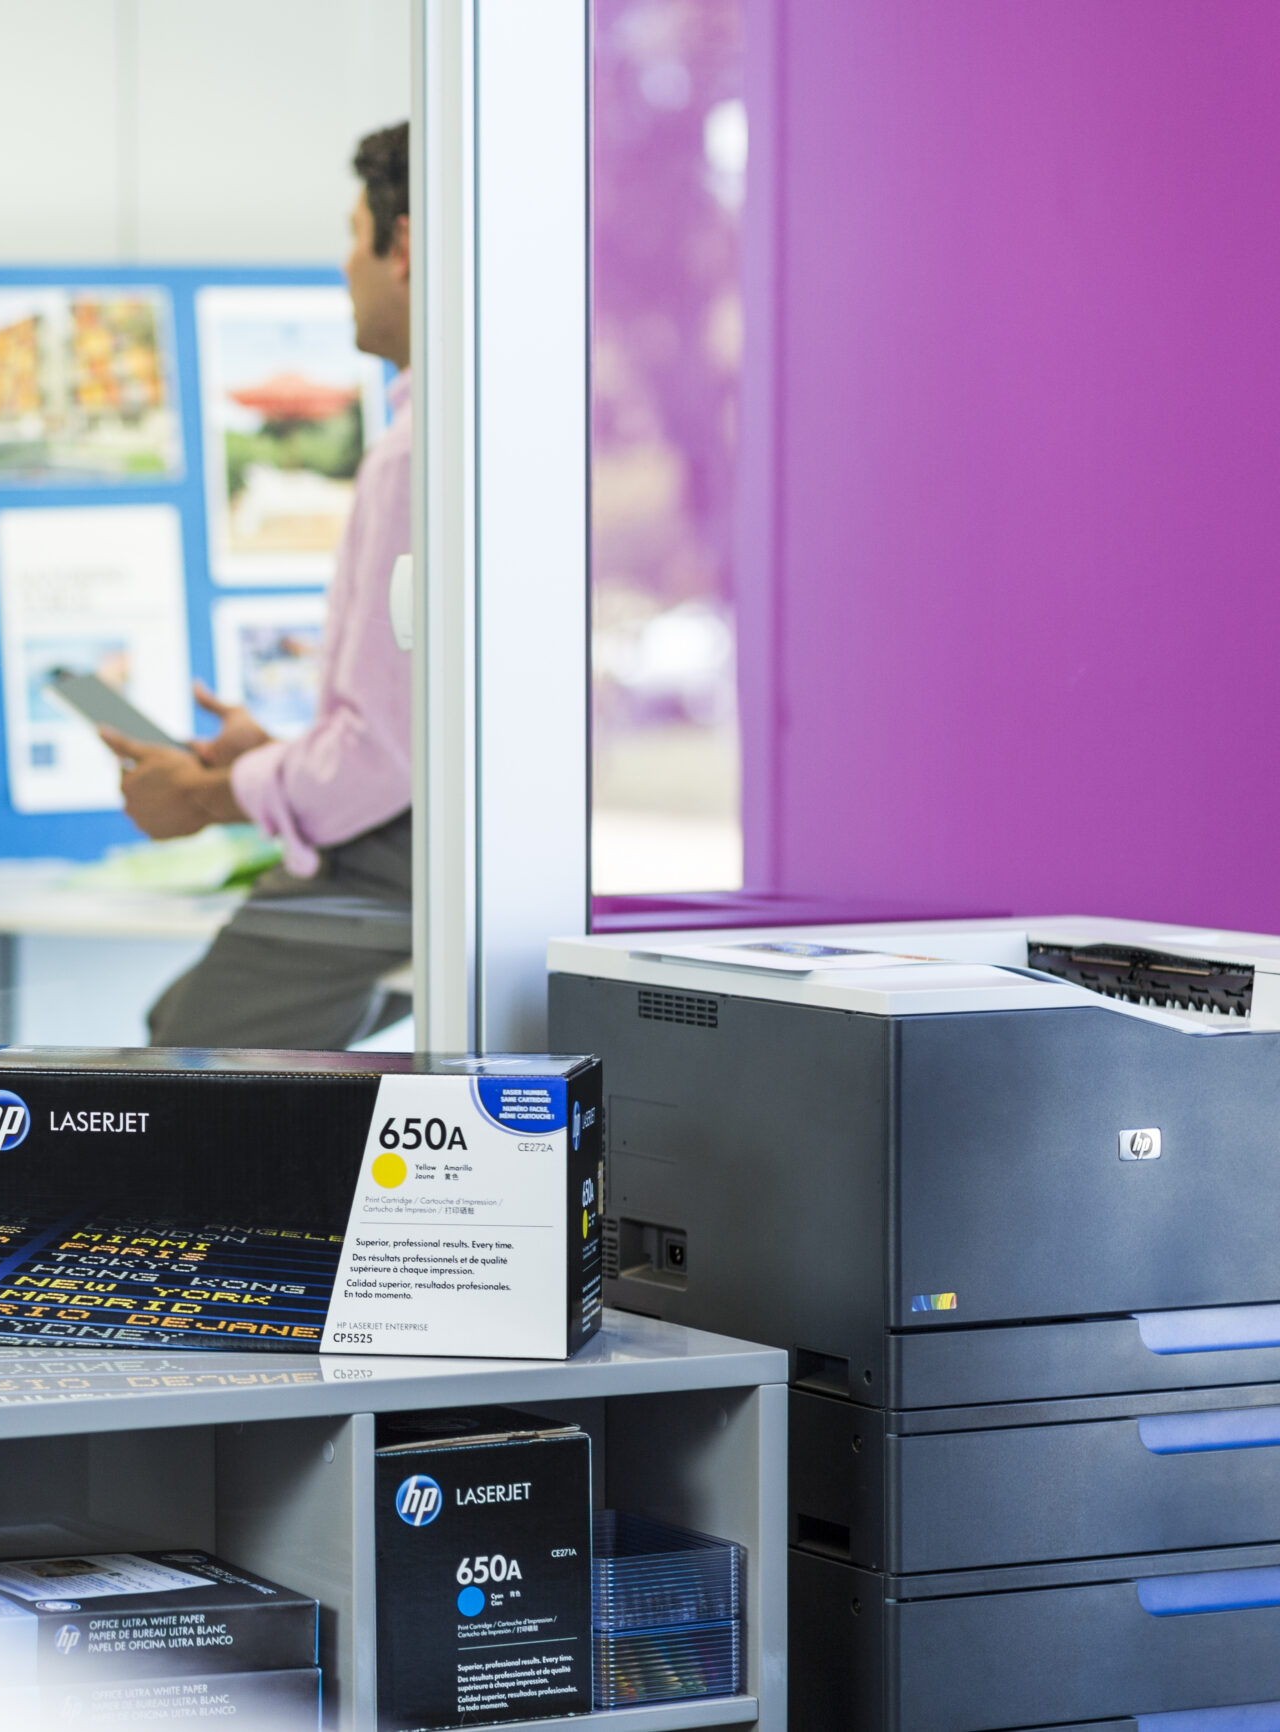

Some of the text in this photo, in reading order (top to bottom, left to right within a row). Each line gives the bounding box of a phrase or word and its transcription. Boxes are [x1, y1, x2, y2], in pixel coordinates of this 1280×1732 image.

[50, 1111, 150, 1132] LASERJET
[379, 1117, 468, 1150] 650A
[518, 1142, 554, 1152] CE272A
[1131, 1131, 1152, 1160] hp
[444, 1164, 472, 1172] Amarillo
[380, 1196, 412, 1206] Cartridge
[420, 1197, 455, 1205] Cartouche
[362, 1206, 394, 1214] Cartucho
[394, 1206, 404, 1214] de
[72, 1232, 211, 1251] MIAMI
[84, 1223, 249, 1244] LONDON
[59, 1242, 208, 1262] PARIS
[356, 1238, 514, 1251] Superior, professional results. Every time.
[51, 1252, 198, 1273] TOKYO
[352, 1254, 508, 1266] Des résultats professionnels et de qualité
[350, 1265, 391, 1274] supérieure
[400, 1265, 428, 1276] chaque
[430, 1266, 475, 1276] impression.
[30, 1264, 306, 1295] HONG KONG
[346, 1278, 512, 1292] Calidad superior, resultados profesionales.
[14, 1275, 272, 1306] NEW YORK
[344, 1290, 413, 1300] En todo momento.
[336, 1322, 428, 1332] HP LASERJET ENTERPRISE
[332, 1333, 373, 1344] CP5525
[399, 1474, 532, 1527] hp LASERJET
[551, 1548, 578, 1558] CE271A
[456, 1554, 523, 1585] 650A
[490, 1592, 504, 1600] Cyan
[89, 1614, 206, 1630] OFFICE ULTRA WHITE PAPER
[469, 1622, 492, 1630] Cartridge
[55, 1624, 82, 1654] hp
[89, 1624, 226, 1641] PAPIER DE BUREAU ULTRA BLANC
[88, 1635, 234, 1654] PAPEL DE OFICINA ULTRA BLANCO
[458, 1654, 574, 1672] Superior, professional results. Every time.
[470, 1673, 494, 1682] résultats
[494, 1668, 536, 1681] professionnels
[536, 1668, 542, 1676] et
[542, 1666, 550, 1675] de
[550, 1665, 572, 1676] qualité
[125, 1688, 150, 1698] ULTRA
[152, 1686, 180, 1696] WHITE
[182, 1684, 208, 1694] PAPER
[458, 1682, 488, 1693] supérieure
[494, 1680, 516, 1689] chaque
[516, 1676, 550, 1688] impression.
[172, 1696, 198, 1706] ULTRA
[200, 1694, 230, 1704] BLANC
[458, 1684, 578, 1704] Calidad superior, resultados profesionales.
[172, 1707, 198, 1718] ULTRA
[200, 1706, 236, 1716] BLANCO
[458, 1702, 509, 1712] En todo momento.
